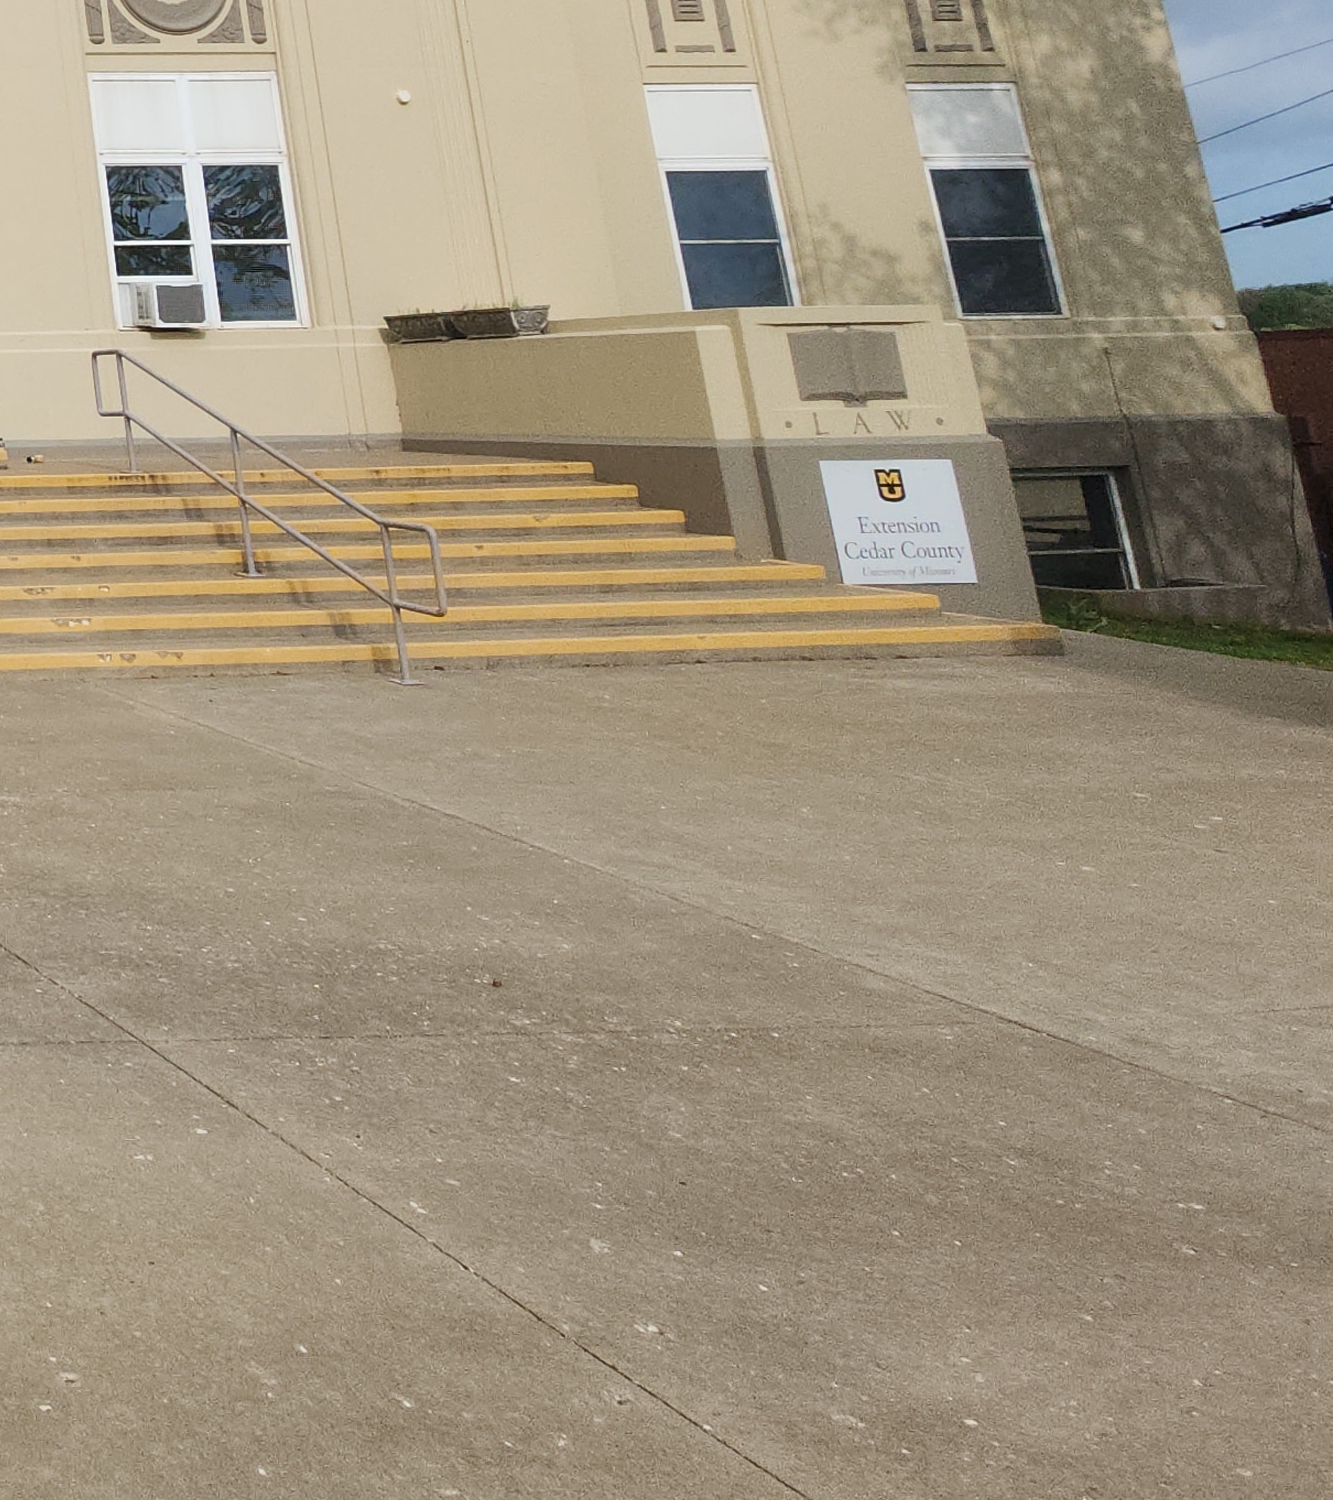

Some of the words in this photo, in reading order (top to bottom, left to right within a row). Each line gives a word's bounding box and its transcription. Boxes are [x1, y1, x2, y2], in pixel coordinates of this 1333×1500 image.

[812, 410, 910, 436] LAW
[857, 516, 941, 534] Extension
[844, 541, 895, 560] Cedar
[900, 541, 965, 563] County
